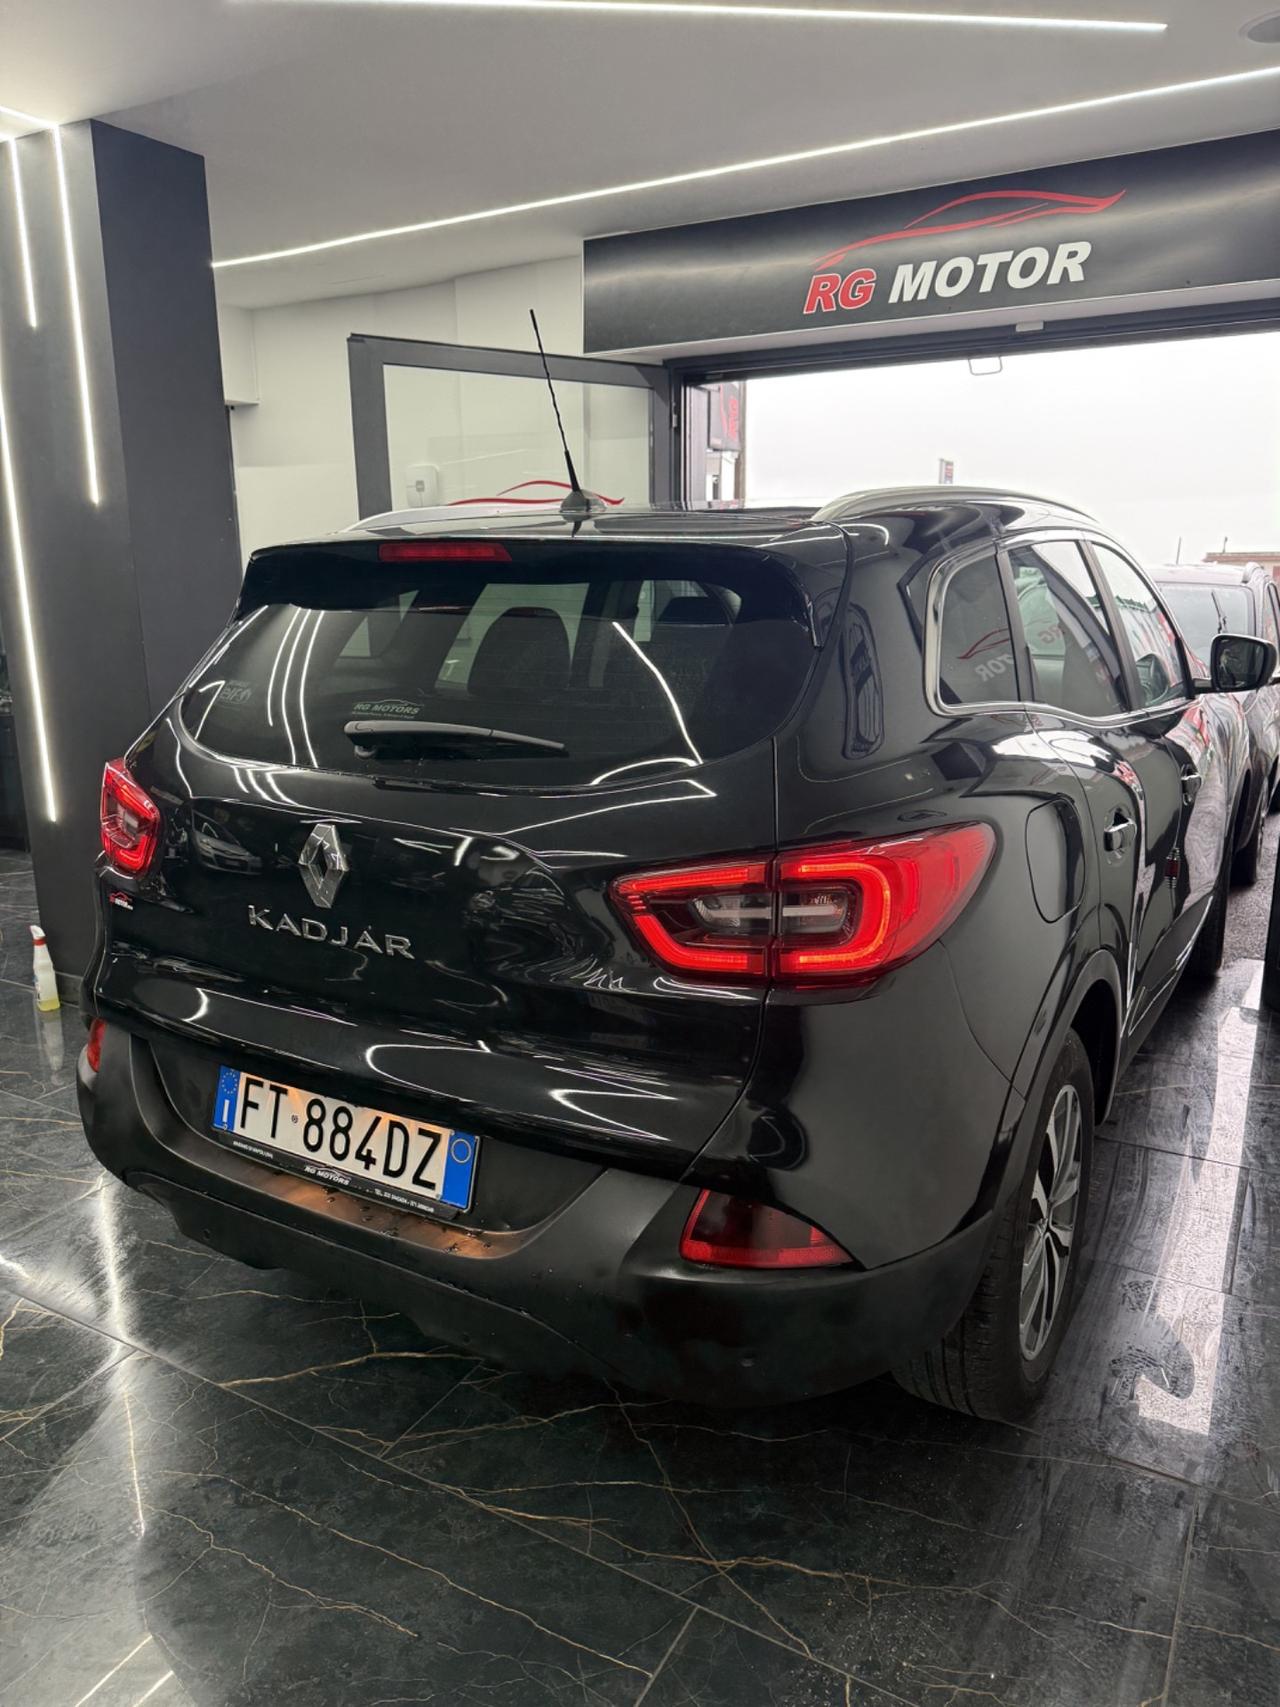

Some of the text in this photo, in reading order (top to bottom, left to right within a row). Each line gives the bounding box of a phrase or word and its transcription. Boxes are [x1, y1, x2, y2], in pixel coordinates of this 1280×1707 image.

[803, 241, 1092, 315] RG MOTOR
[372, 704, 420, 715] MOTORS
[316, 1168, 350, 1186] MOTORS
